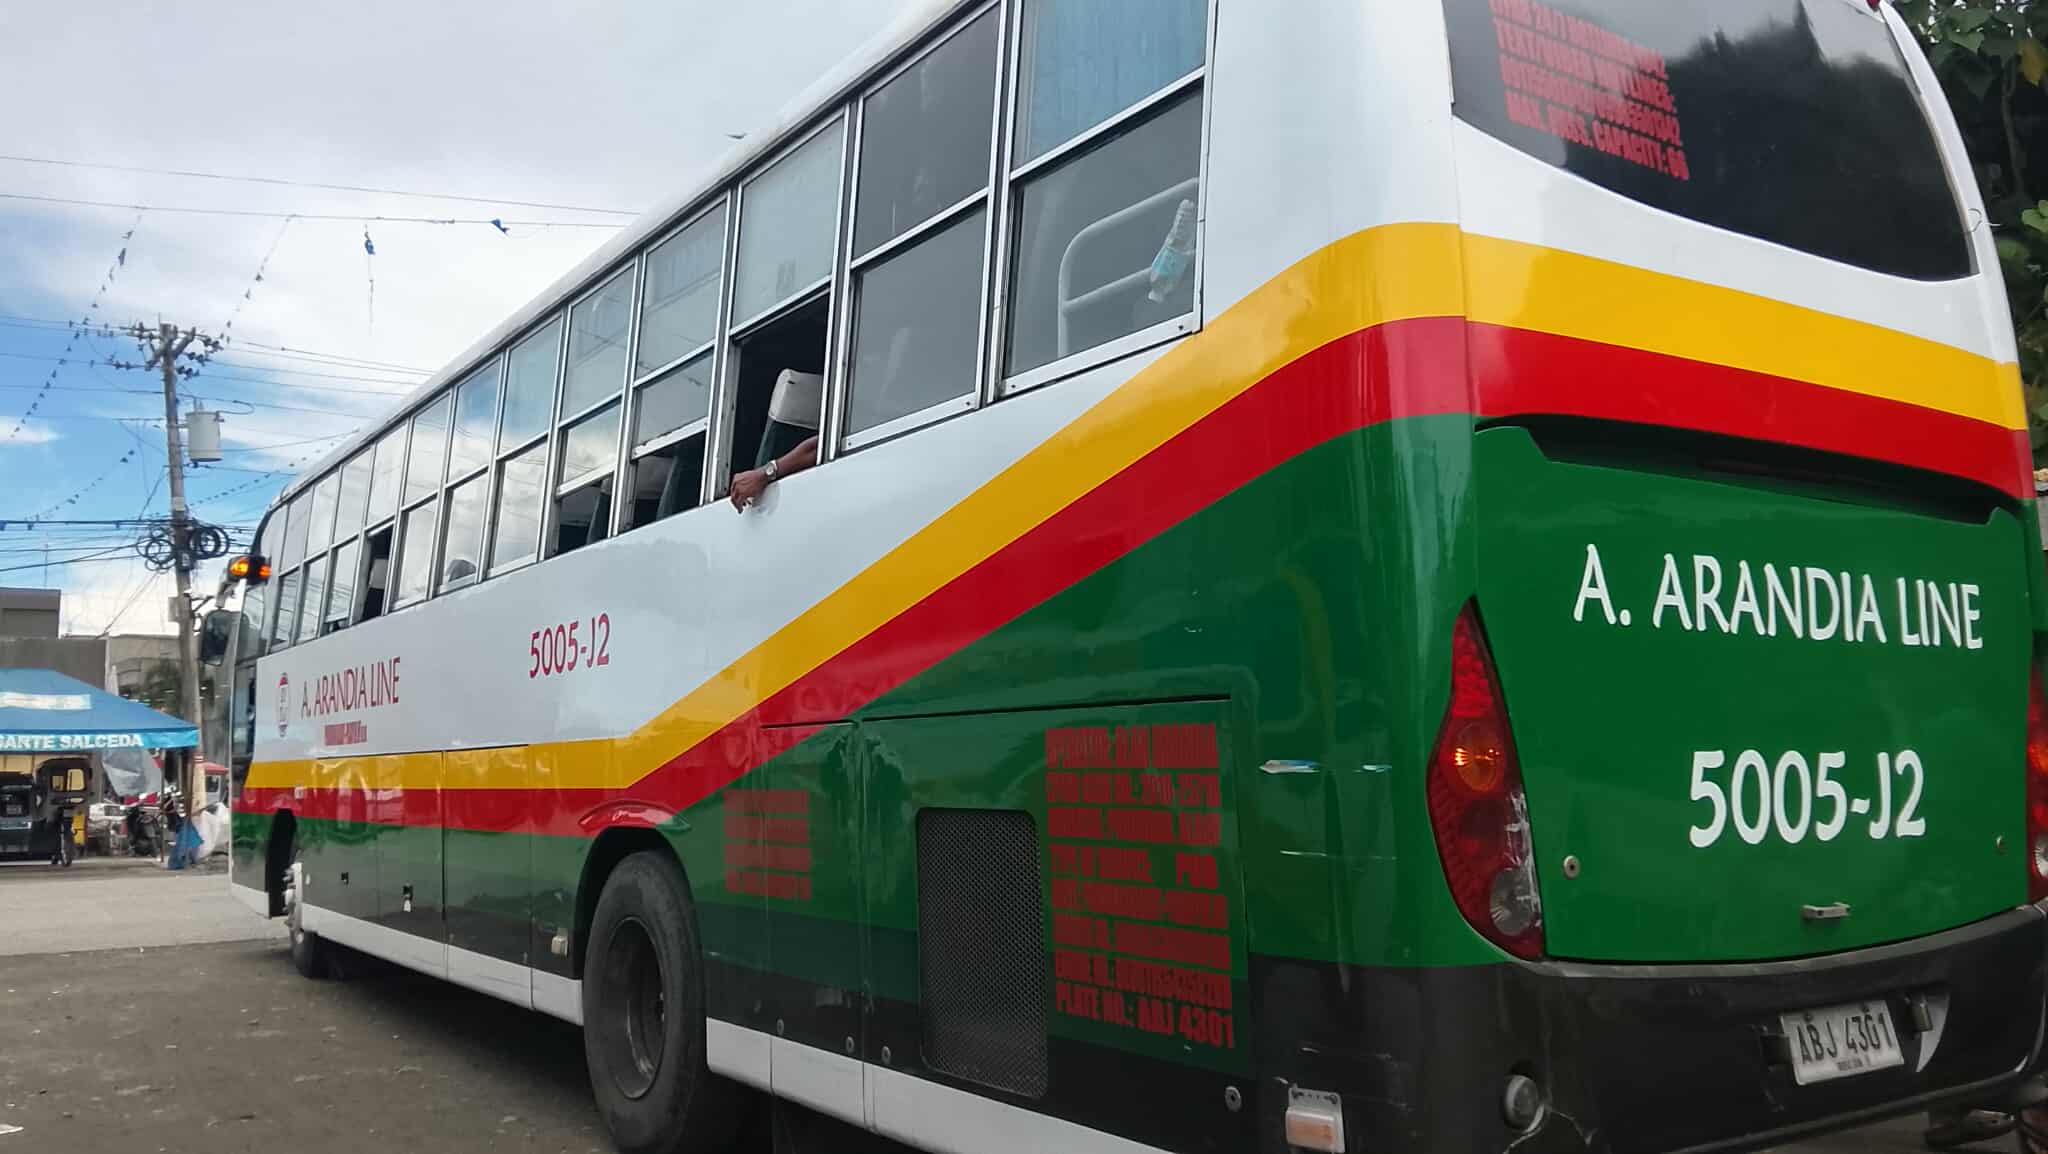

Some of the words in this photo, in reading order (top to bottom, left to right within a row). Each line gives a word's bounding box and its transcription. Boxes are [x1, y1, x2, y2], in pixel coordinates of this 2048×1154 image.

[1573, 543, 1631, 627] A.
[1652, 553, 1887, 644] ARANDIA
[1896, 577, 1983, 649] LINE
[529, 612, 610, 679] 5005-J2
[301, 680, 312, 720] A.
[314, 666, 368, 716] ARANDIA
[371, 656, 401, 707] LINE
[60, 734, 144, 748] SALCEDA
[1688, 749, 1926, 848] 5005-J2
[1055, 981, 1098, 1019] PLATE
[1179, 1005, 1233, 1049] 4301
[1796, 1021, 1838, 1064] ABJ
[1844, 1012, 1893, 1054] 4301
